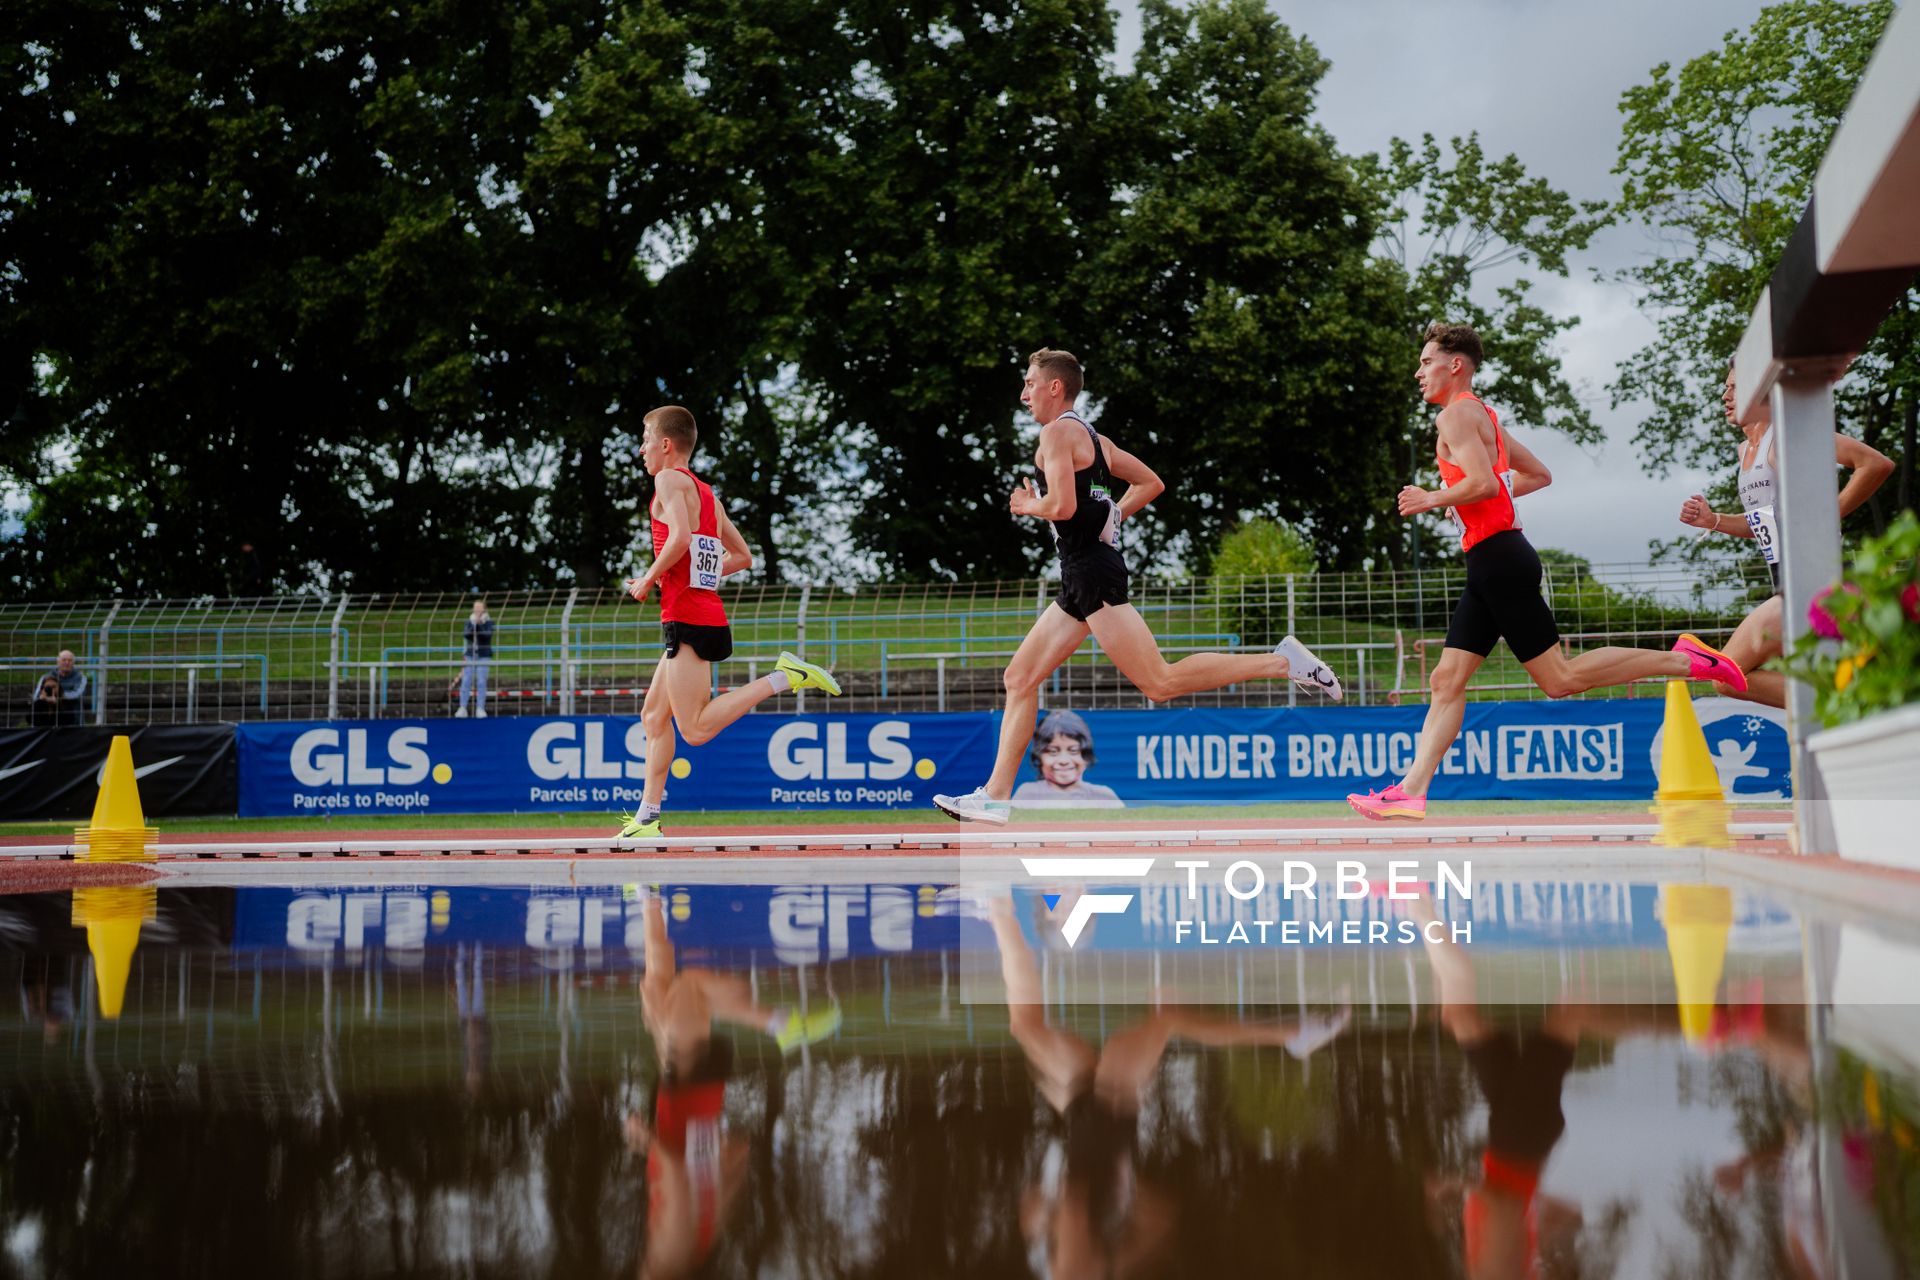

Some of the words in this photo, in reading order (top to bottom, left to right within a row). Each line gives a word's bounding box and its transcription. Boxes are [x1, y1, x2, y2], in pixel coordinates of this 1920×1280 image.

[699, 537, 716, 551] GLS
[696, 551, 718, 574] 367
[1137, 734, 1276, 779] KINDER
[1506, 728, 1618, 774] FANS!
[293, 792, 350, 809] Parcels
[354, 793, 371, 807] to
[375, 791, 430, 811] People
[530, 786, 588, 802] Parcels
[592, 787, 609, 801] to
[612, 785, 668, 802] Peoe
[771, 787, 830, 803] Parcels
[834, 788, 852, 802] to
[856, 786, 913, 806] People
